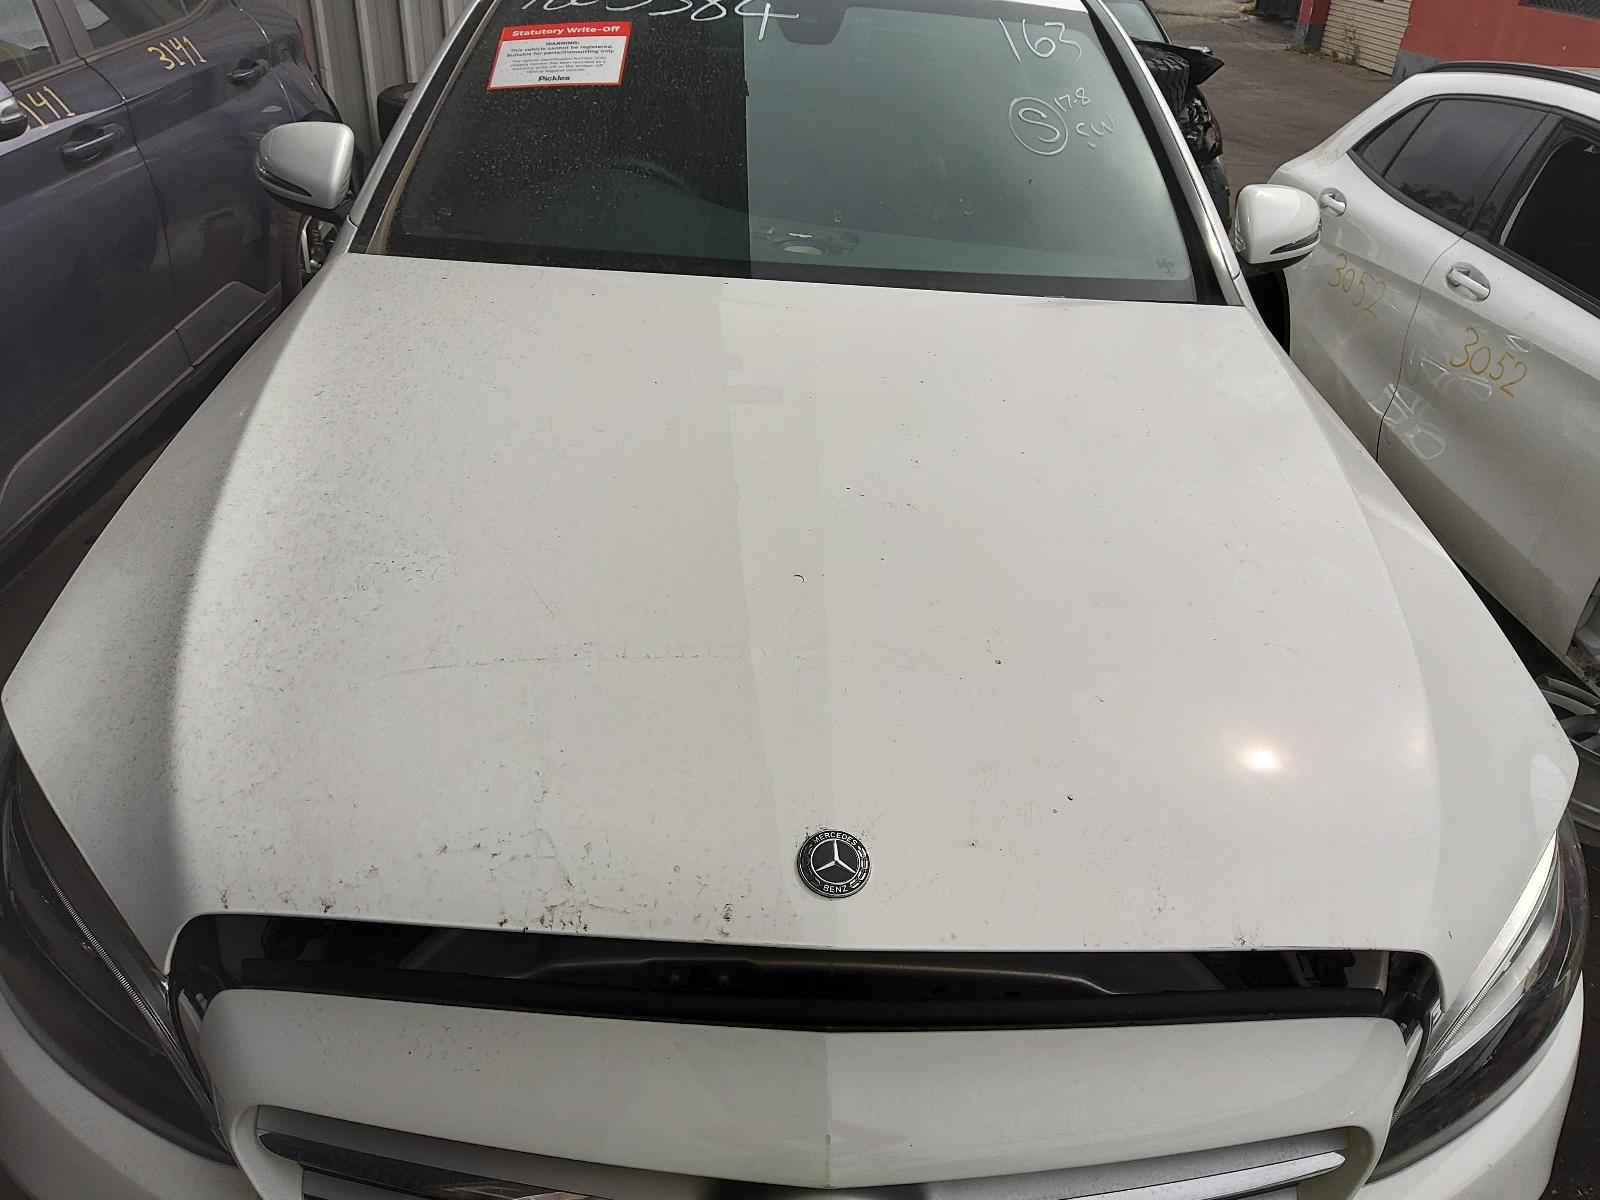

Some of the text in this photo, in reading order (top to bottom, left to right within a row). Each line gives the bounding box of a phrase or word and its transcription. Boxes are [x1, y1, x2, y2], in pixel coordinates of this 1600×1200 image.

[511, 25, 621, 37] Statutory Write-Off
[998, 18, 1083, 63] 163
[147, 36, 207, 71] 3141
[18, 86, 76, 131] 141
[1327, 252, 1388, 319] 3052
[1449, 326, 1528, 398] 3052
[812, 832, 858, 846] MERCEDES
[822, 884, 849, 893] BENZ
